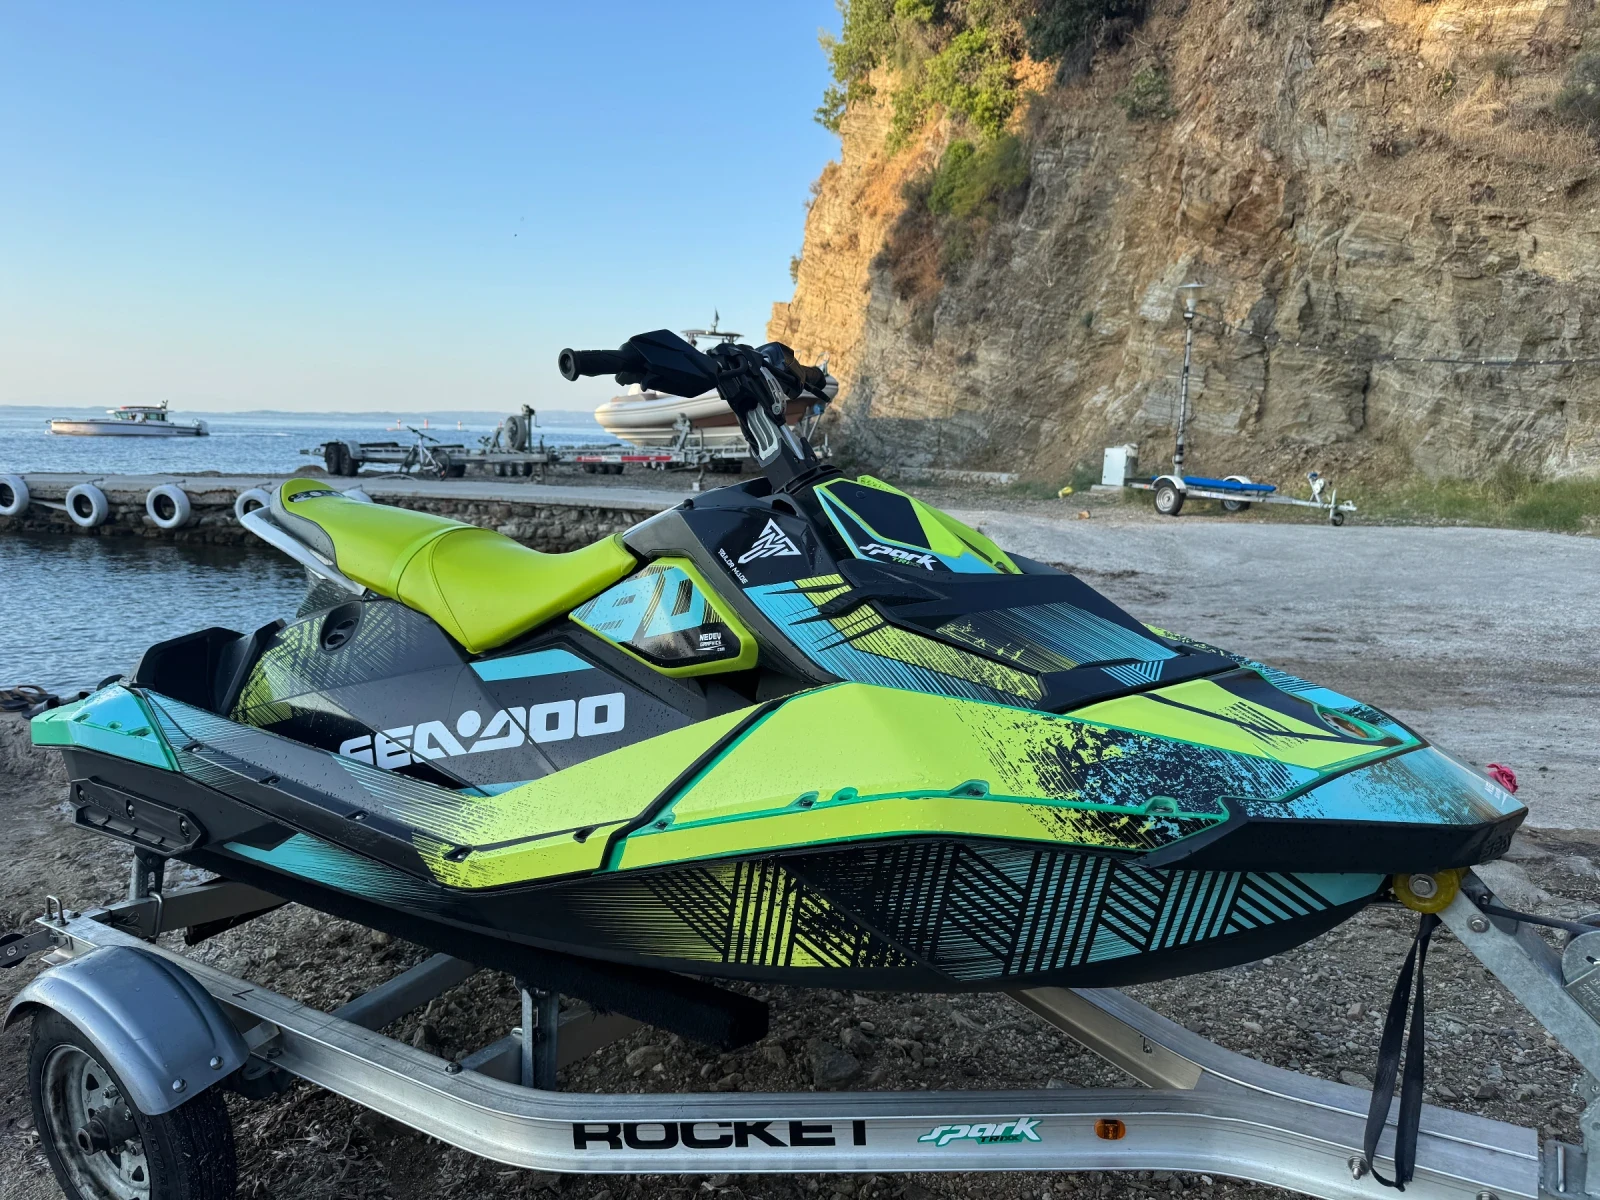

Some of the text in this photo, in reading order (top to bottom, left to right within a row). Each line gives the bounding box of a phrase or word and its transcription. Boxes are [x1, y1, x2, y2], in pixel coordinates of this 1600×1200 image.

[717, 547, 749, 585] TAILOR MADE
[699, 632, 721, 641] NEDEV
